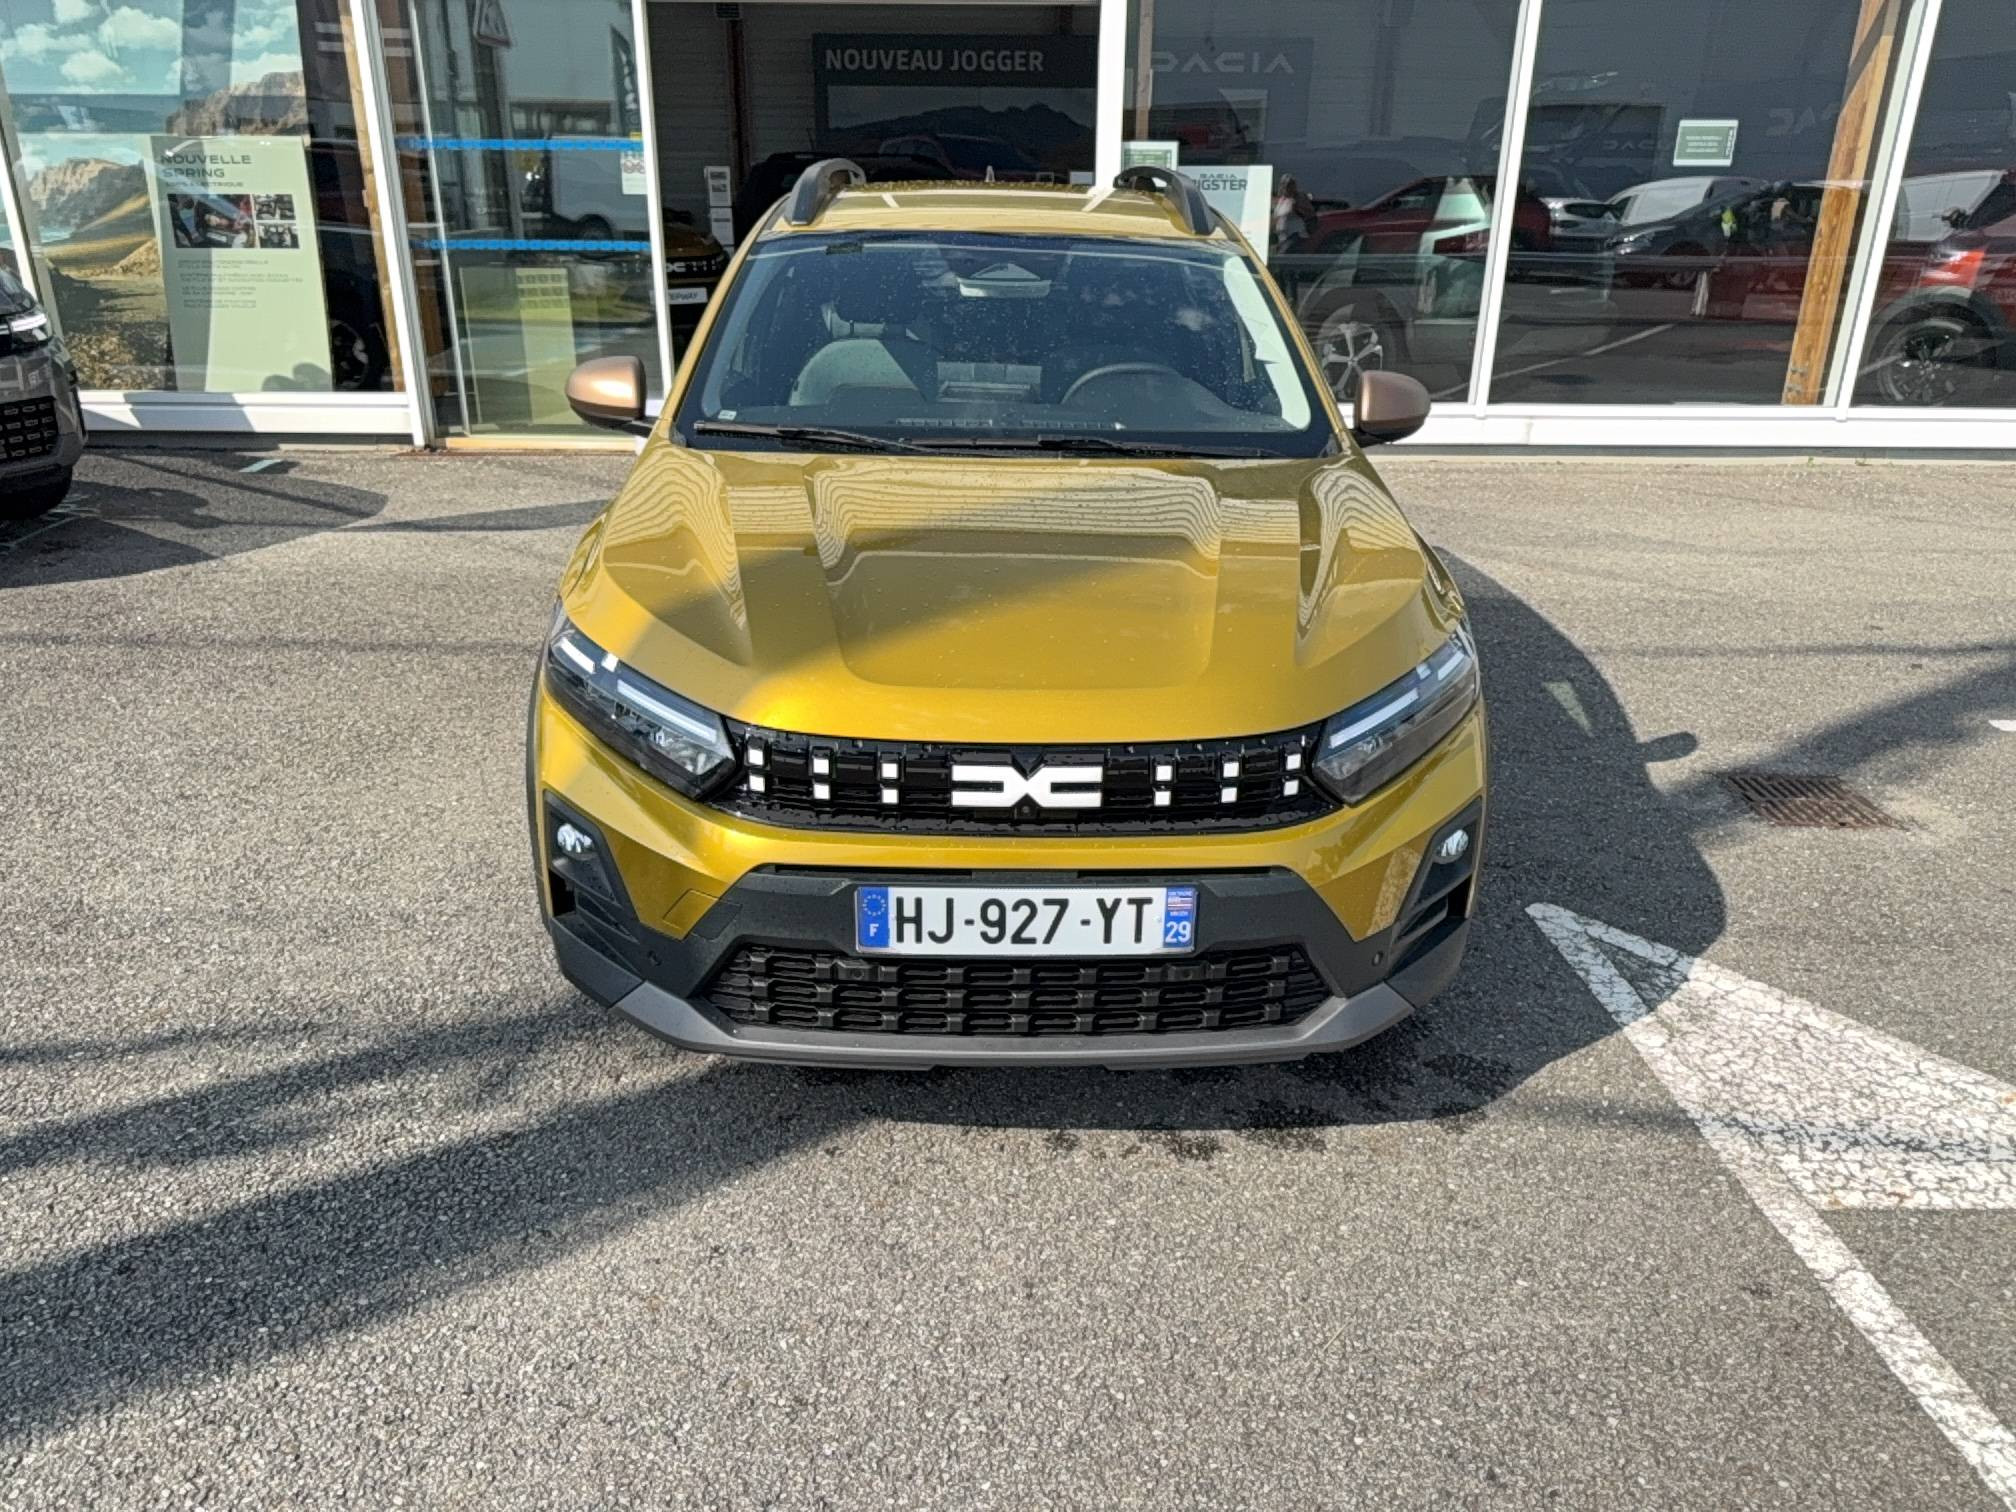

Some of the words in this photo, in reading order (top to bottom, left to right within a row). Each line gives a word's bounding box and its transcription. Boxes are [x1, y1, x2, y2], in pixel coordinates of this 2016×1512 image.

[825, 49, 943, 70] NOUVEAU
[949, 50, 1044, 71] JOGGER
[1151, 51, 1295, 73] DACIA
[161, 154, 252, 165] NOUVELLE
[162, 167, 225, 178] SPRING
[1192, 178, 1248, 191] IGSTER
[896, 897, 1153, 944] HJ-927-YT
[869, 924, 879, 937] F
[1165, 921, 1191, 943] 29
